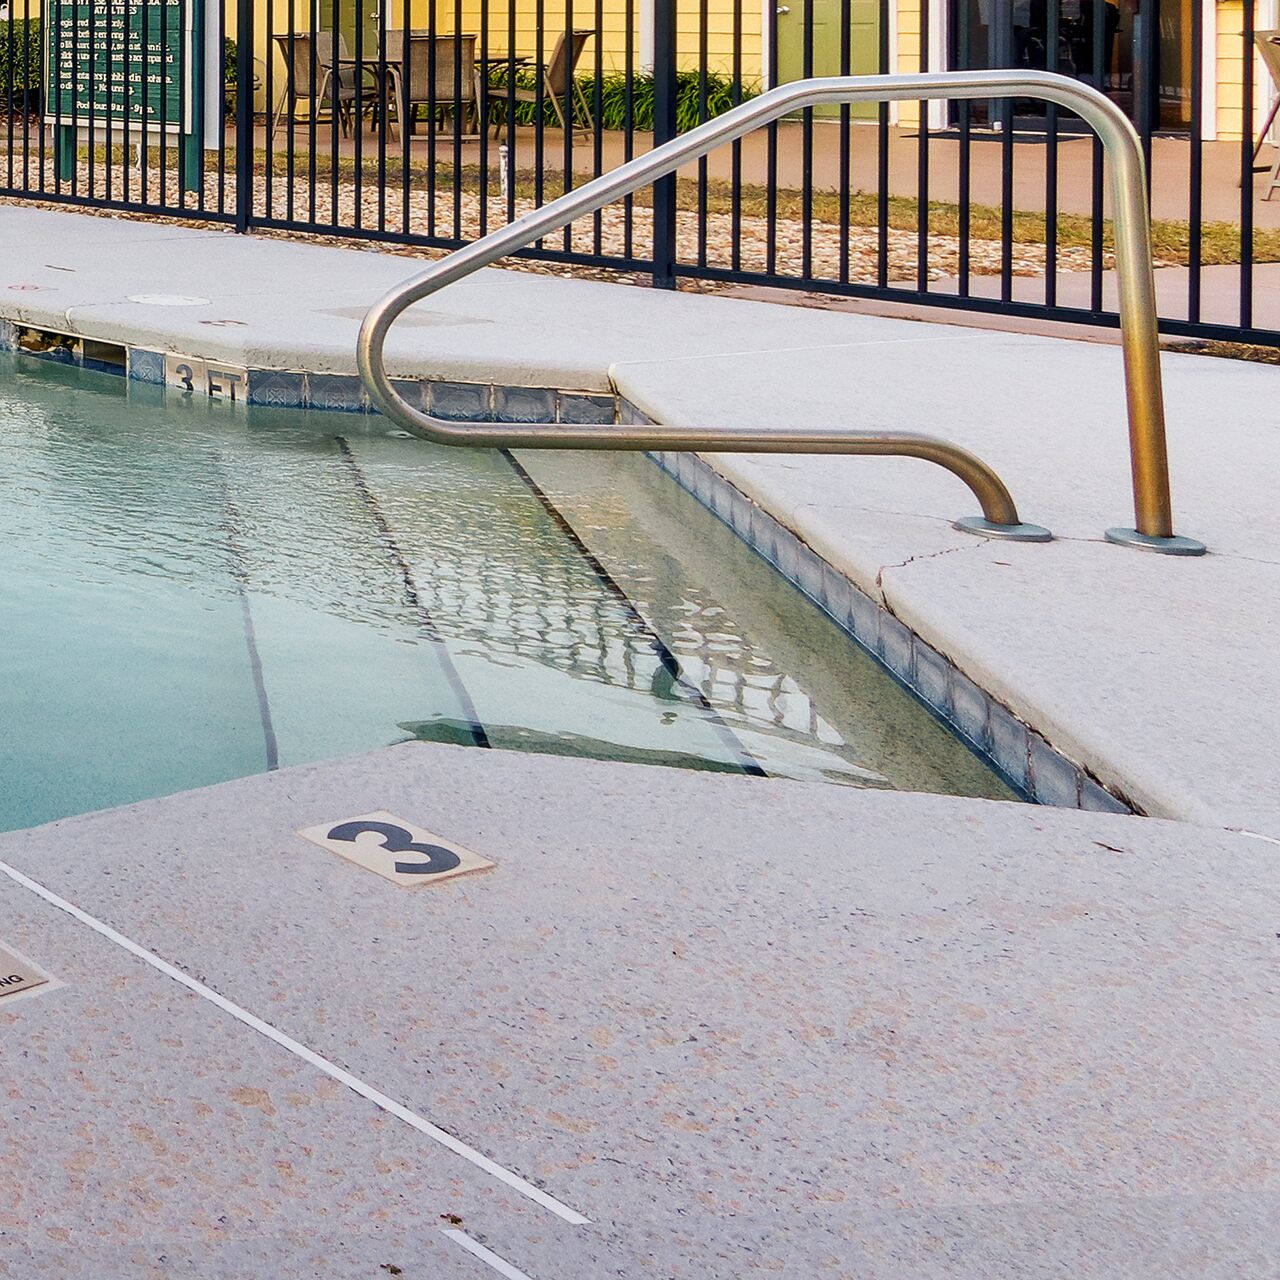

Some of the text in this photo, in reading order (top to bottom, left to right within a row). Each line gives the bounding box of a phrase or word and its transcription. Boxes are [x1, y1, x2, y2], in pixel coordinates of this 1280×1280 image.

[175, 363, 242, 401] 3 FT
[327, 820, 461, 875] 3
